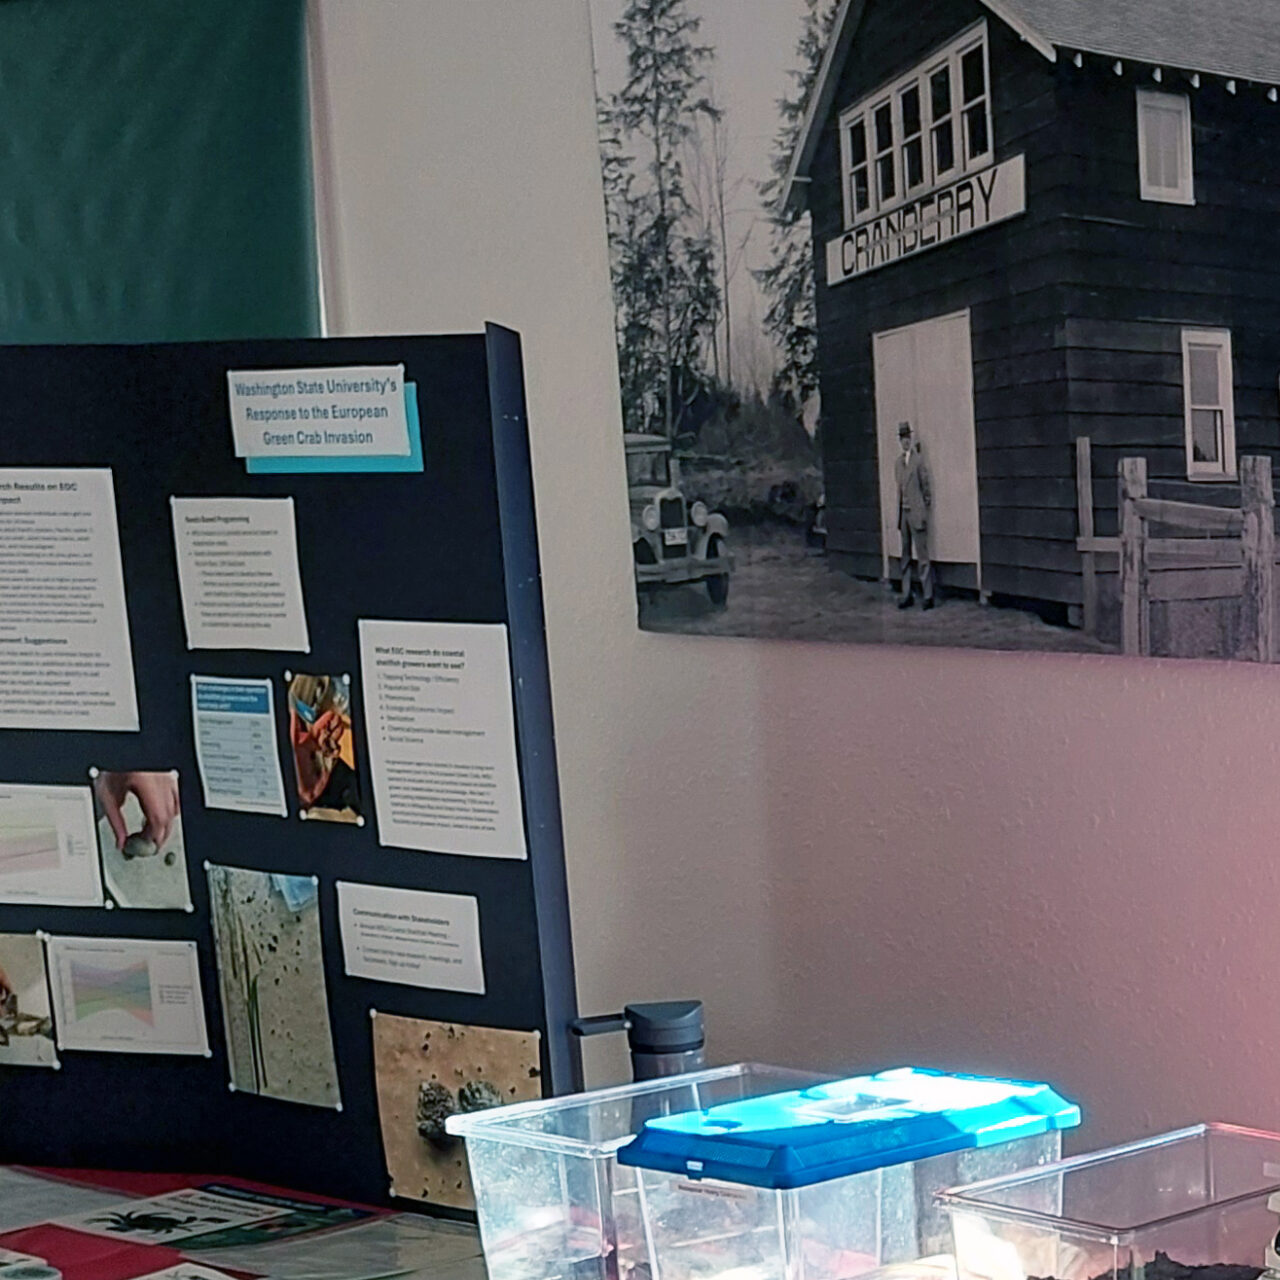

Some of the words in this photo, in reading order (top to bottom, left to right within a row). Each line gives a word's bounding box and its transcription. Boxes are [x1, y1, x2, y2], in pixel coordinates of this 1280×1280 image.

[841, 168, 998, 276] CRANBERRY
[235, 382, 295, 399] Washington
[297, 381, 324, 395] State
[326, 377, 397, 395] University's
[246, 407, 297, 423] Response
[298, 407, 309, 420] to
[311, 406, 329, 420] the
[331, 405, 389, 421] European
[263, 431, 295, 445] Green
[296, 430, 321, 444] Crab
[324, 429, 374, 444] Invasion
